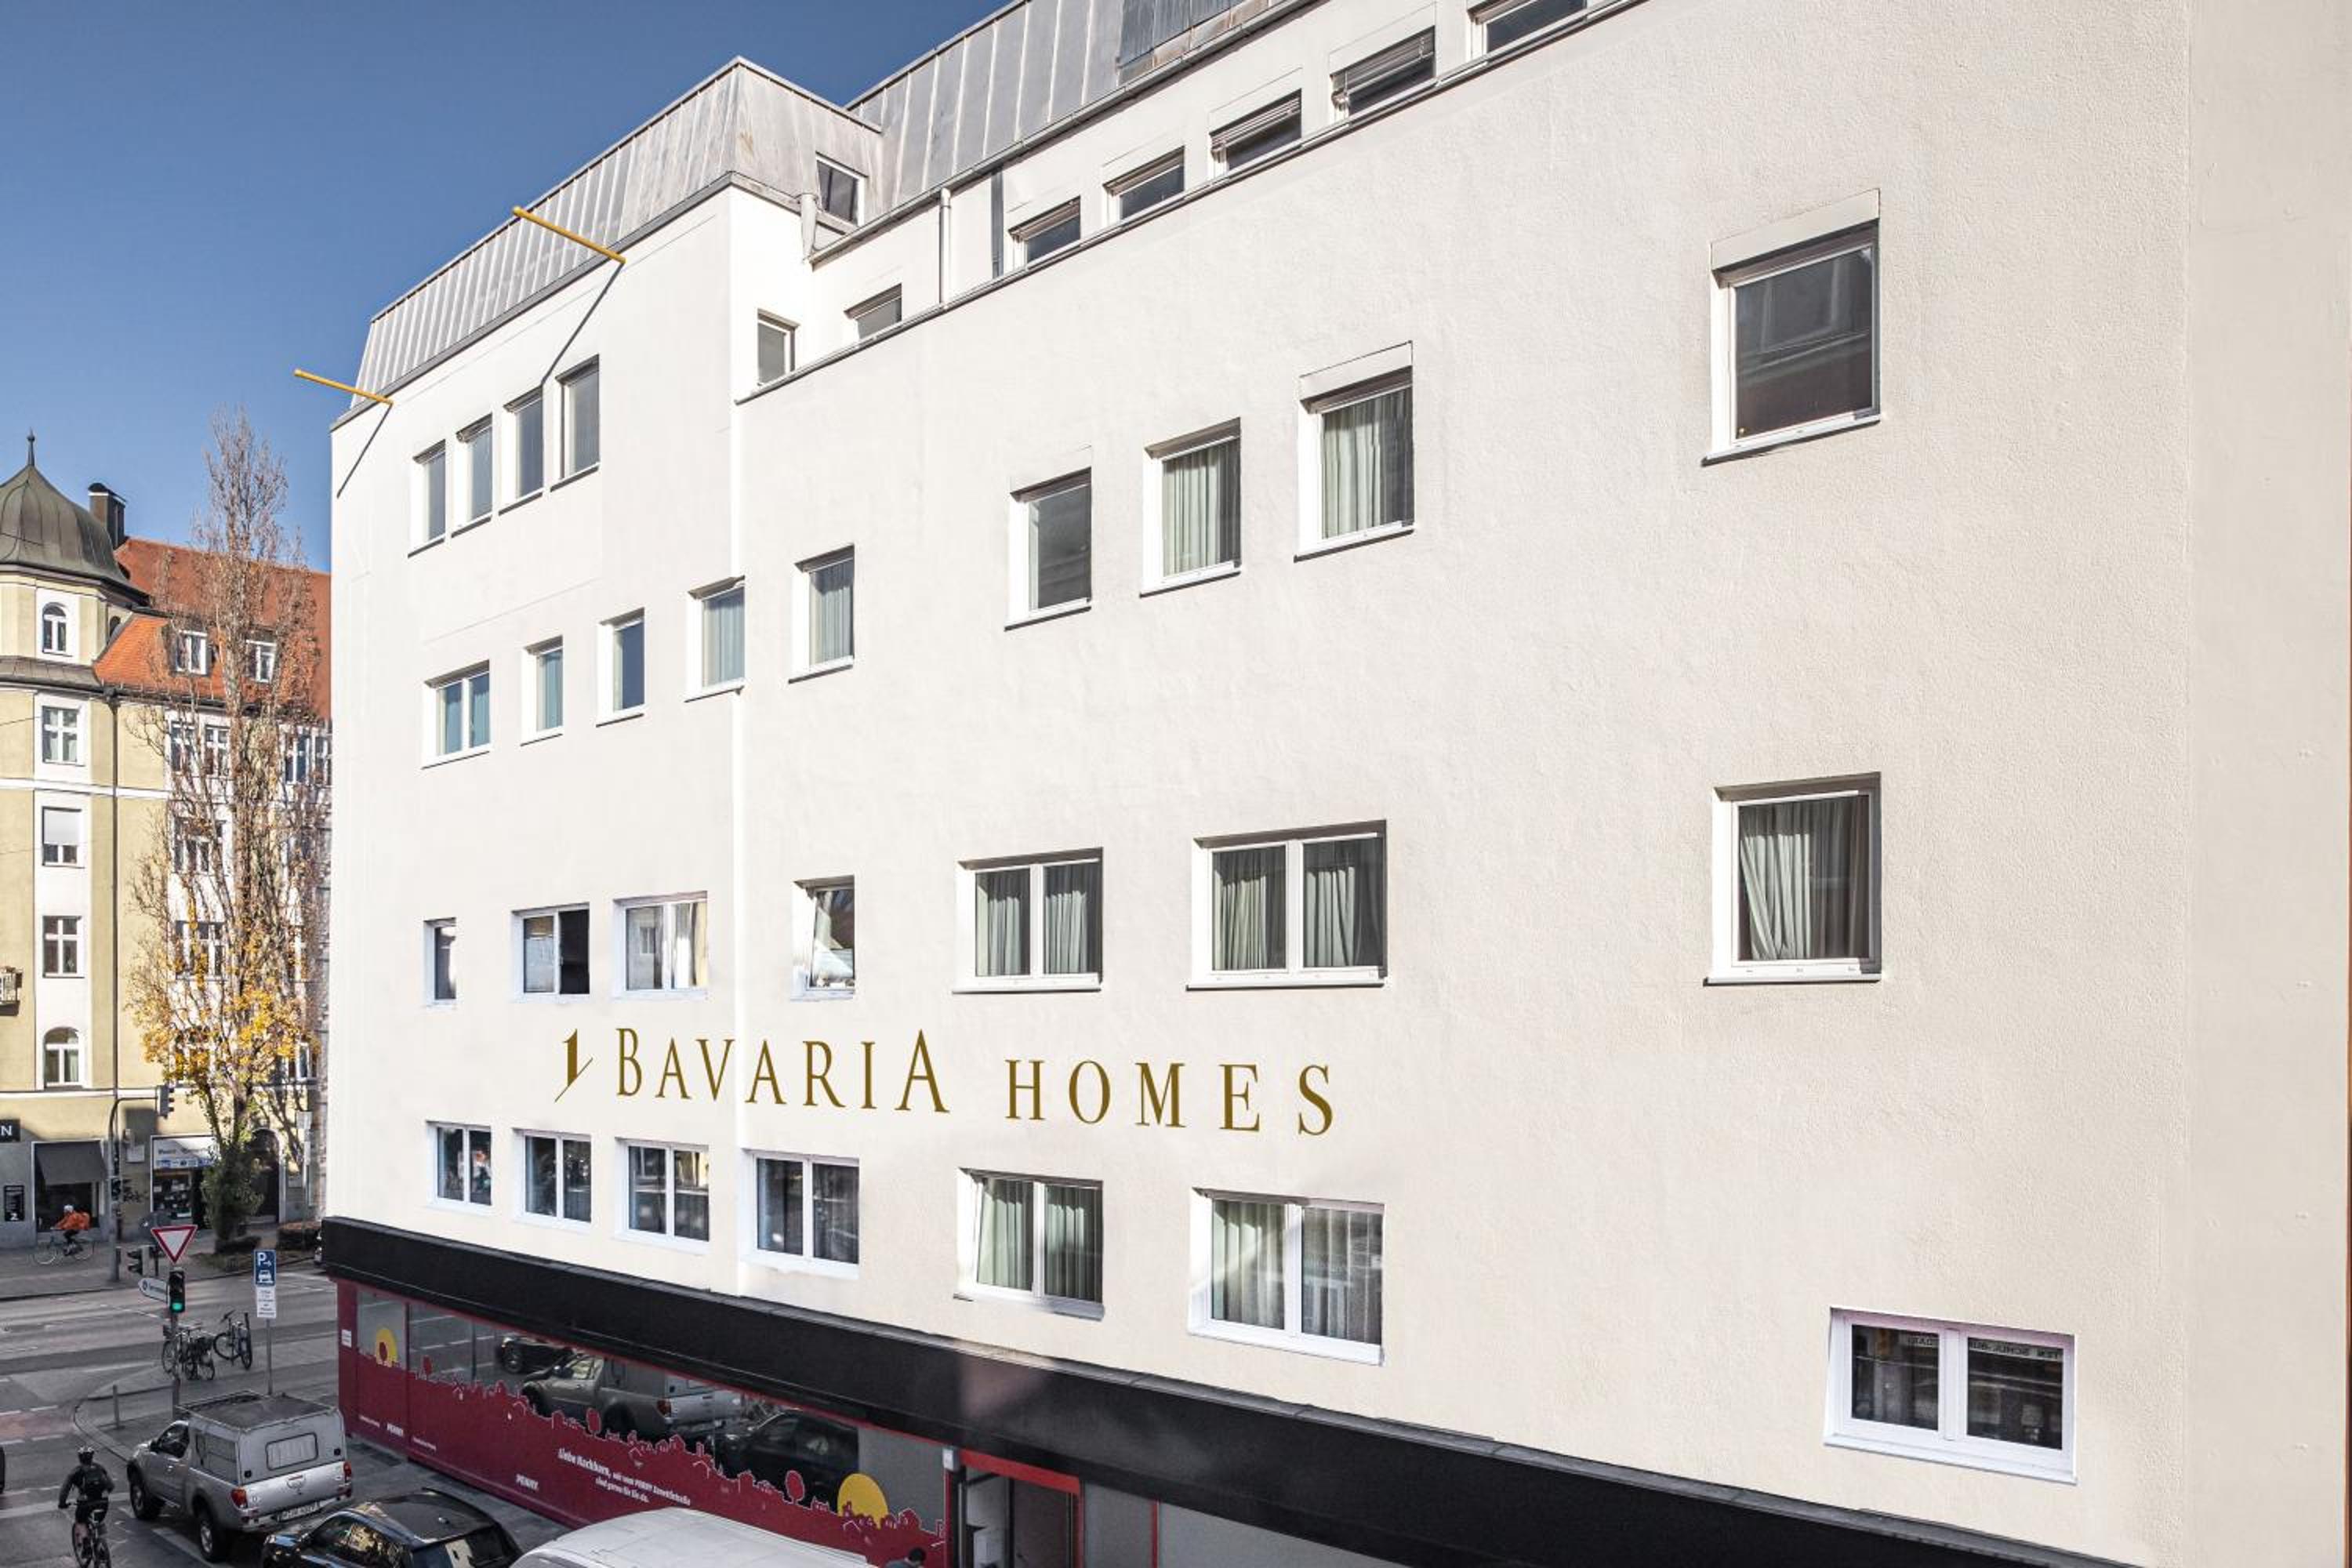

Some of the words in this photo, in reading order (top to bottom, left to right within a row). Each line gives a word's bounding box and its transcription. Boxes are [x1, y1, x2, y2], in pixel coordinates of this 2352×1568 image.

[616, 1028, 949, 1113] BAVARIA
[1004, 1059, 1334, 1136] HOMES
[257, 1252, 267, 1266] P
